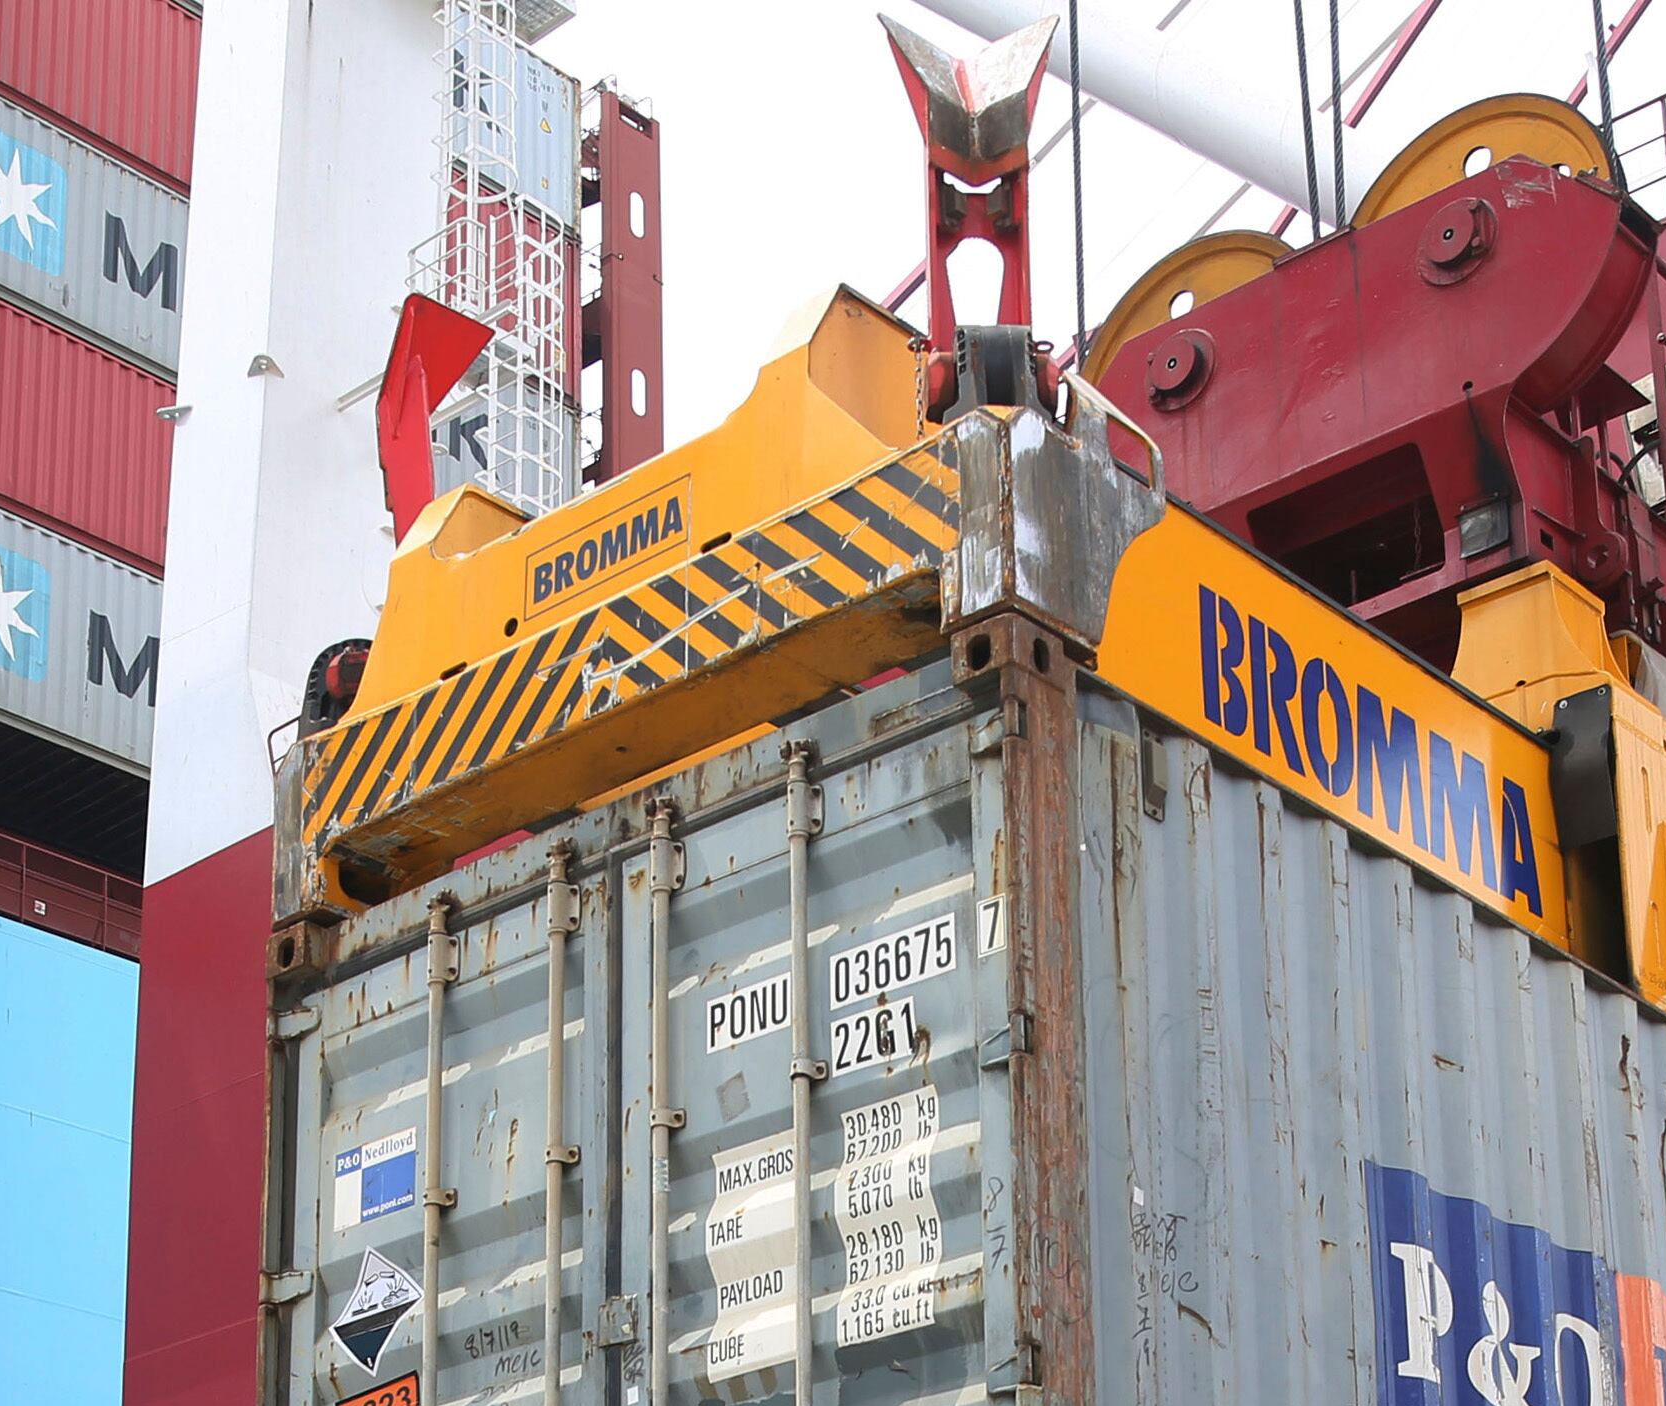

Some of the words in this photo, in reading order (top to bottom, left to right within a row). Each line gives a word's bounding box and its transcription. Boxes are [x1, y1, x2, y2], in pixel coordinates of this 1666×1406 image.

[533, 496, 683, 605] BROMMA
[1197, 582, 1544, 919] BROMMA
[710, 979, 788, 1048] PONU
[835, 921, 952, 1003] 036675
[835, 1003, 917, 1071] 22G1
[846, 1101, 902, 1140] 30.480
[916, 1094, 936, 1119] kg
[337, 1153, 360, 1172] P&O
[364, 1131, 413, 1161] Nedlloyd
[848, 1183, 893, 1218] 5.070
[908, 1176, 923, 1200] lb
[709, 1215, 743, 1247] TARE
[846, 1221, 903, 1260] 28.180
[916, 1214, 938, 1241] kg
[849, 1249, 904, 1285] 62.130
[920, 1241, 934, 1264] lb
[720, 1269, 783, 1310] PAYLOAD
[851, 1285, 886, 1313] 33.0
[842, 1309, 885, 1342] 1.165
[893, 1298, 931, 1329] cu.ft
[709, 1334, 744, 1365] CUBE
